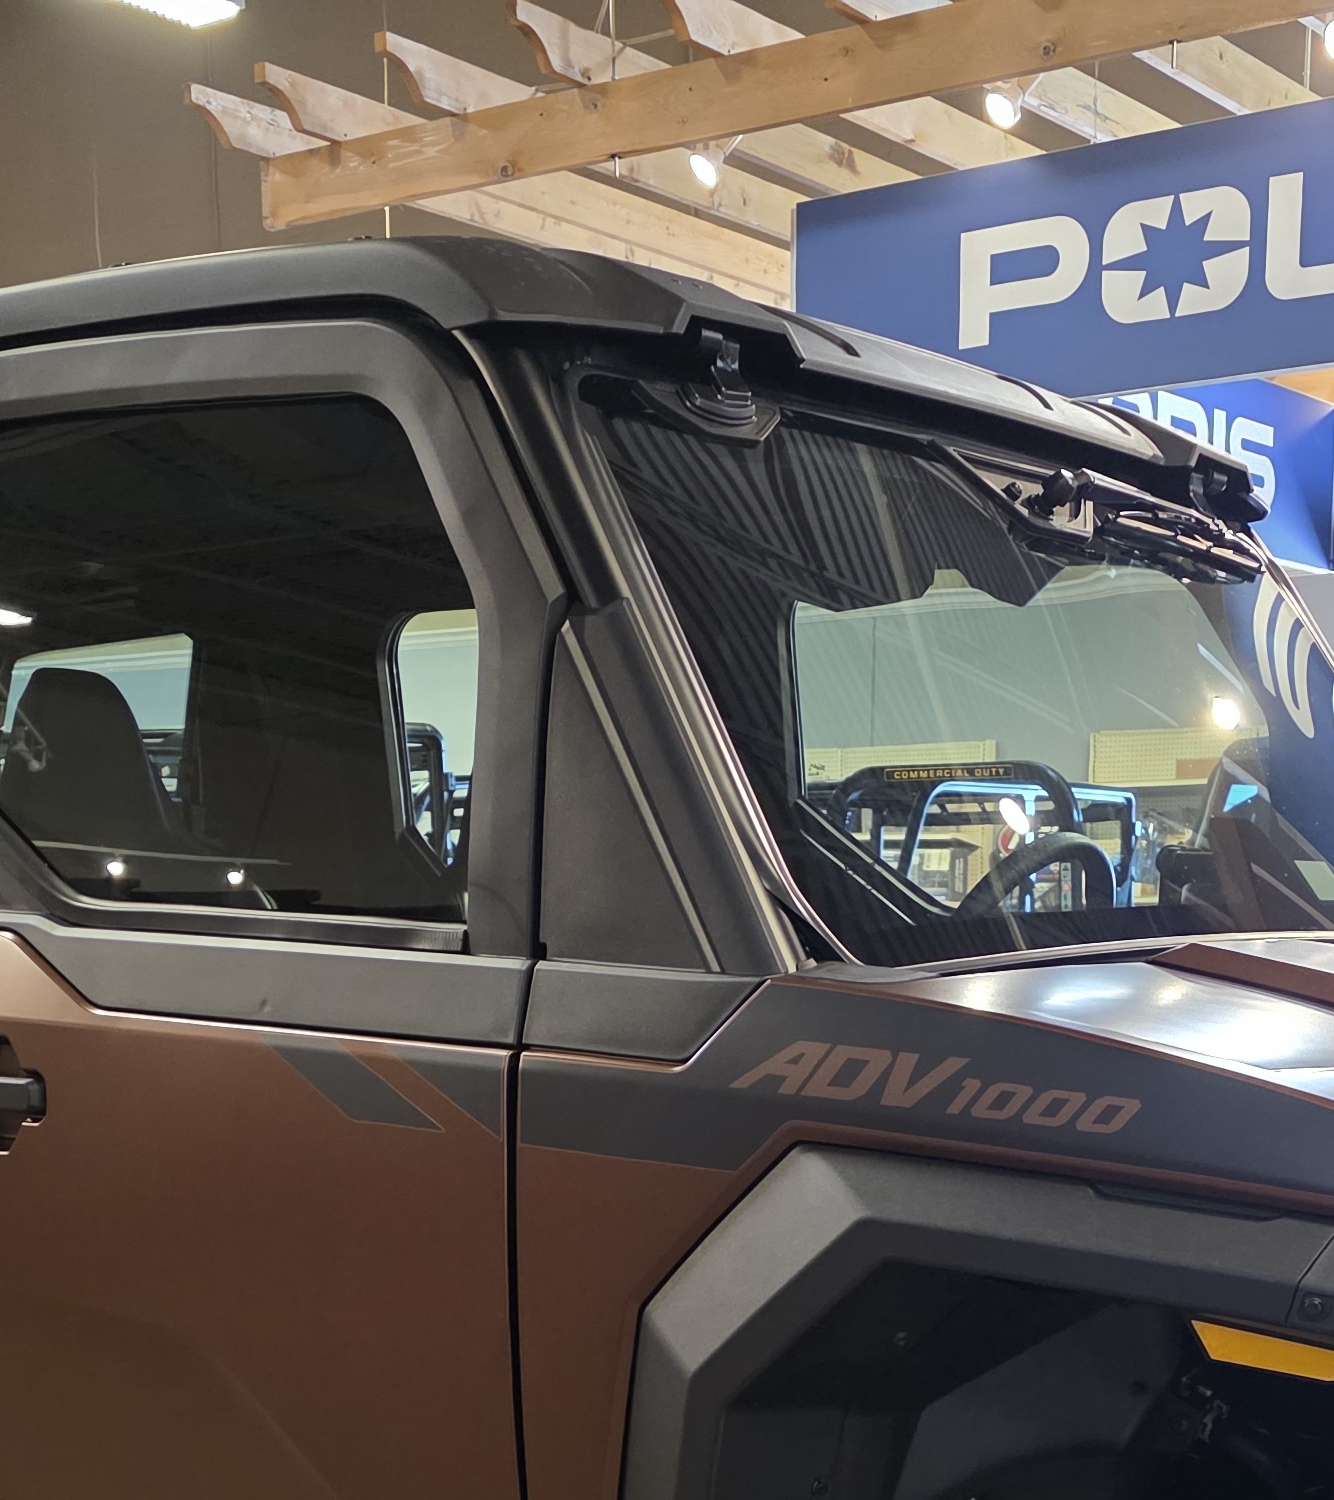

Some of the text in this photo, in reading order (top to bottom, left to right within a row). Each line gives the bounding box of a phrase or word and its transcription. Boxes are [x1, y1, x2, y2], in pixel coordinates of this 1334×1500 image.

[893, 767, 1005, 779] COMMERCIAL DUTY
[729, 1040, 1142, 1135] ADV 1000
